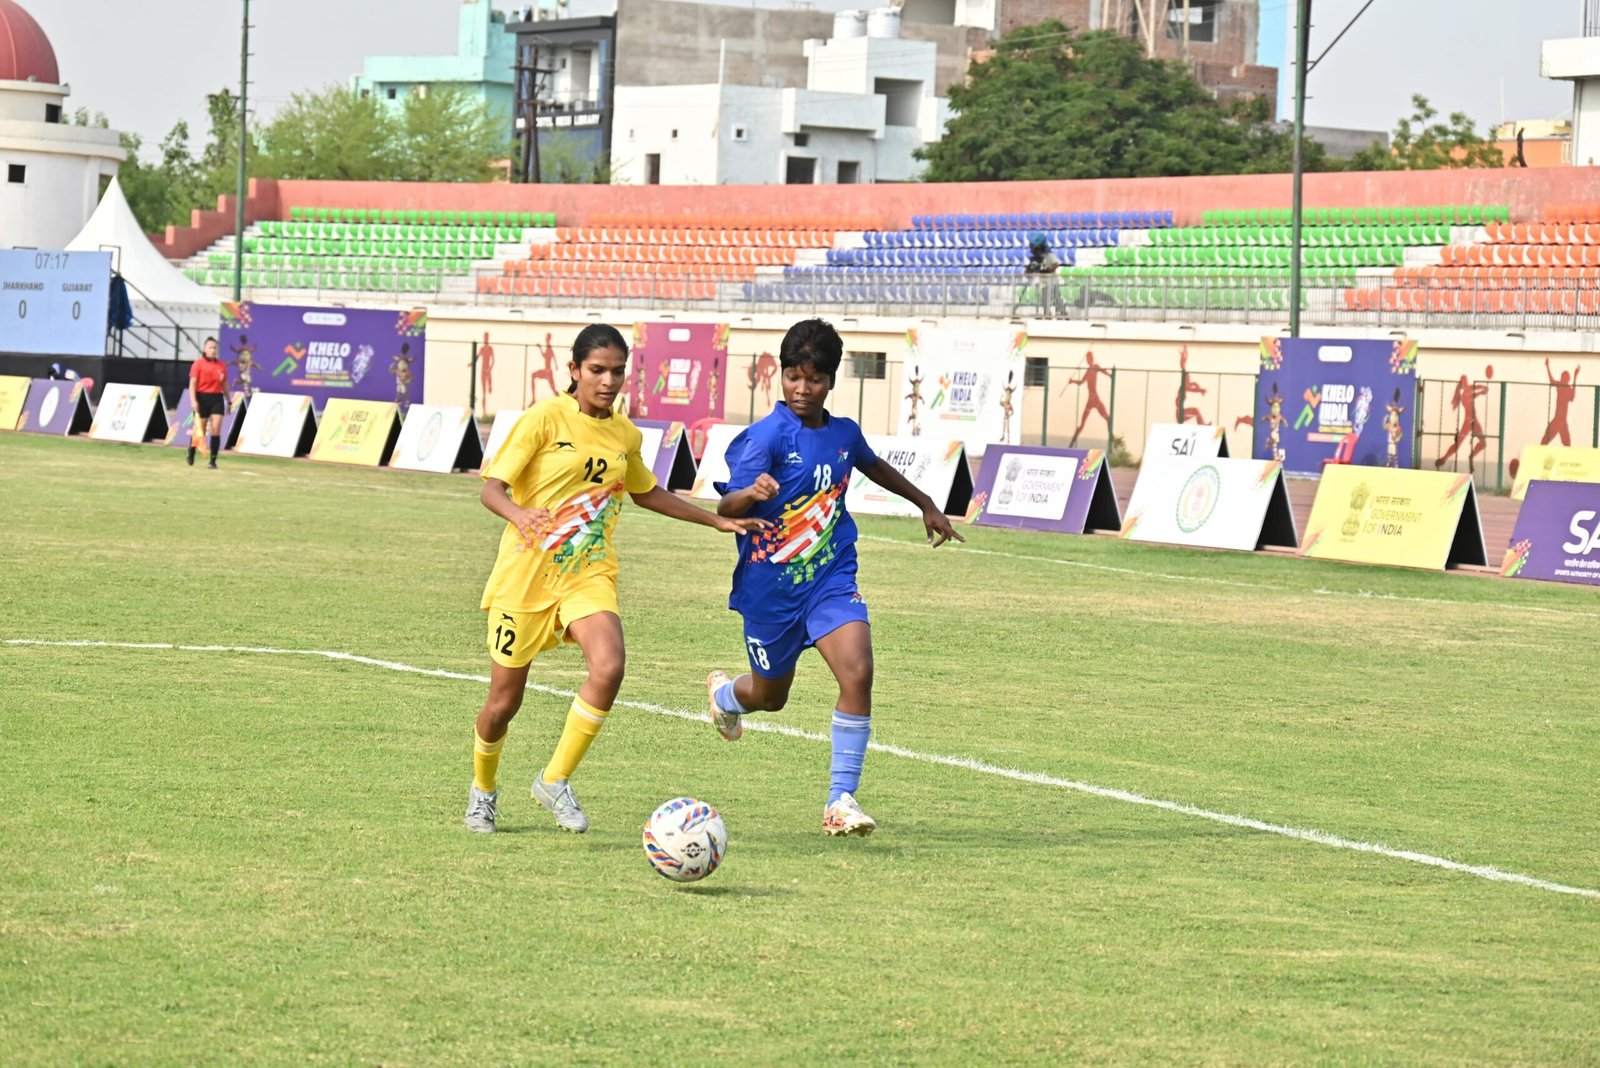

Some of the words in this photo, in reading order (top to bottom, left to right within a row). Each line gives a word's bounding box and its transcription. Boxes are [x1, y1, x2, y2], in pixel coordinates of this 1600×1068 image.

[34, 253, 69, 269] 07:17
[3, 282, 44, 292] JHARKHAND
[62, 283, 93, 292] GUJARAT
[18, 299, 27, 318] 0
[72, 301, 81, 320] 0
[308, 342, 351, 357] KHELO
[306, 356, 343, 372] INDIA
[952, 371, 977, 386] KHELO
[950, 388, 972, 402] INDIA
[1322, 384, 1355, 403] KHELO
[1319, 402, 1348, 420] INDIA
[886, 450, 916, 466] KHELO
[583, 457, 608, 484] 12
[814, 464, 832, 491] 18
[1027, 493, 1048, 504] INDIA
[1371, 508, 1422, 523] GOVERNMENT
[1377, 522, 1402, 536] INDIA
[496, 625, 515, 656] 12
[749, 645, 770, 670] 18
